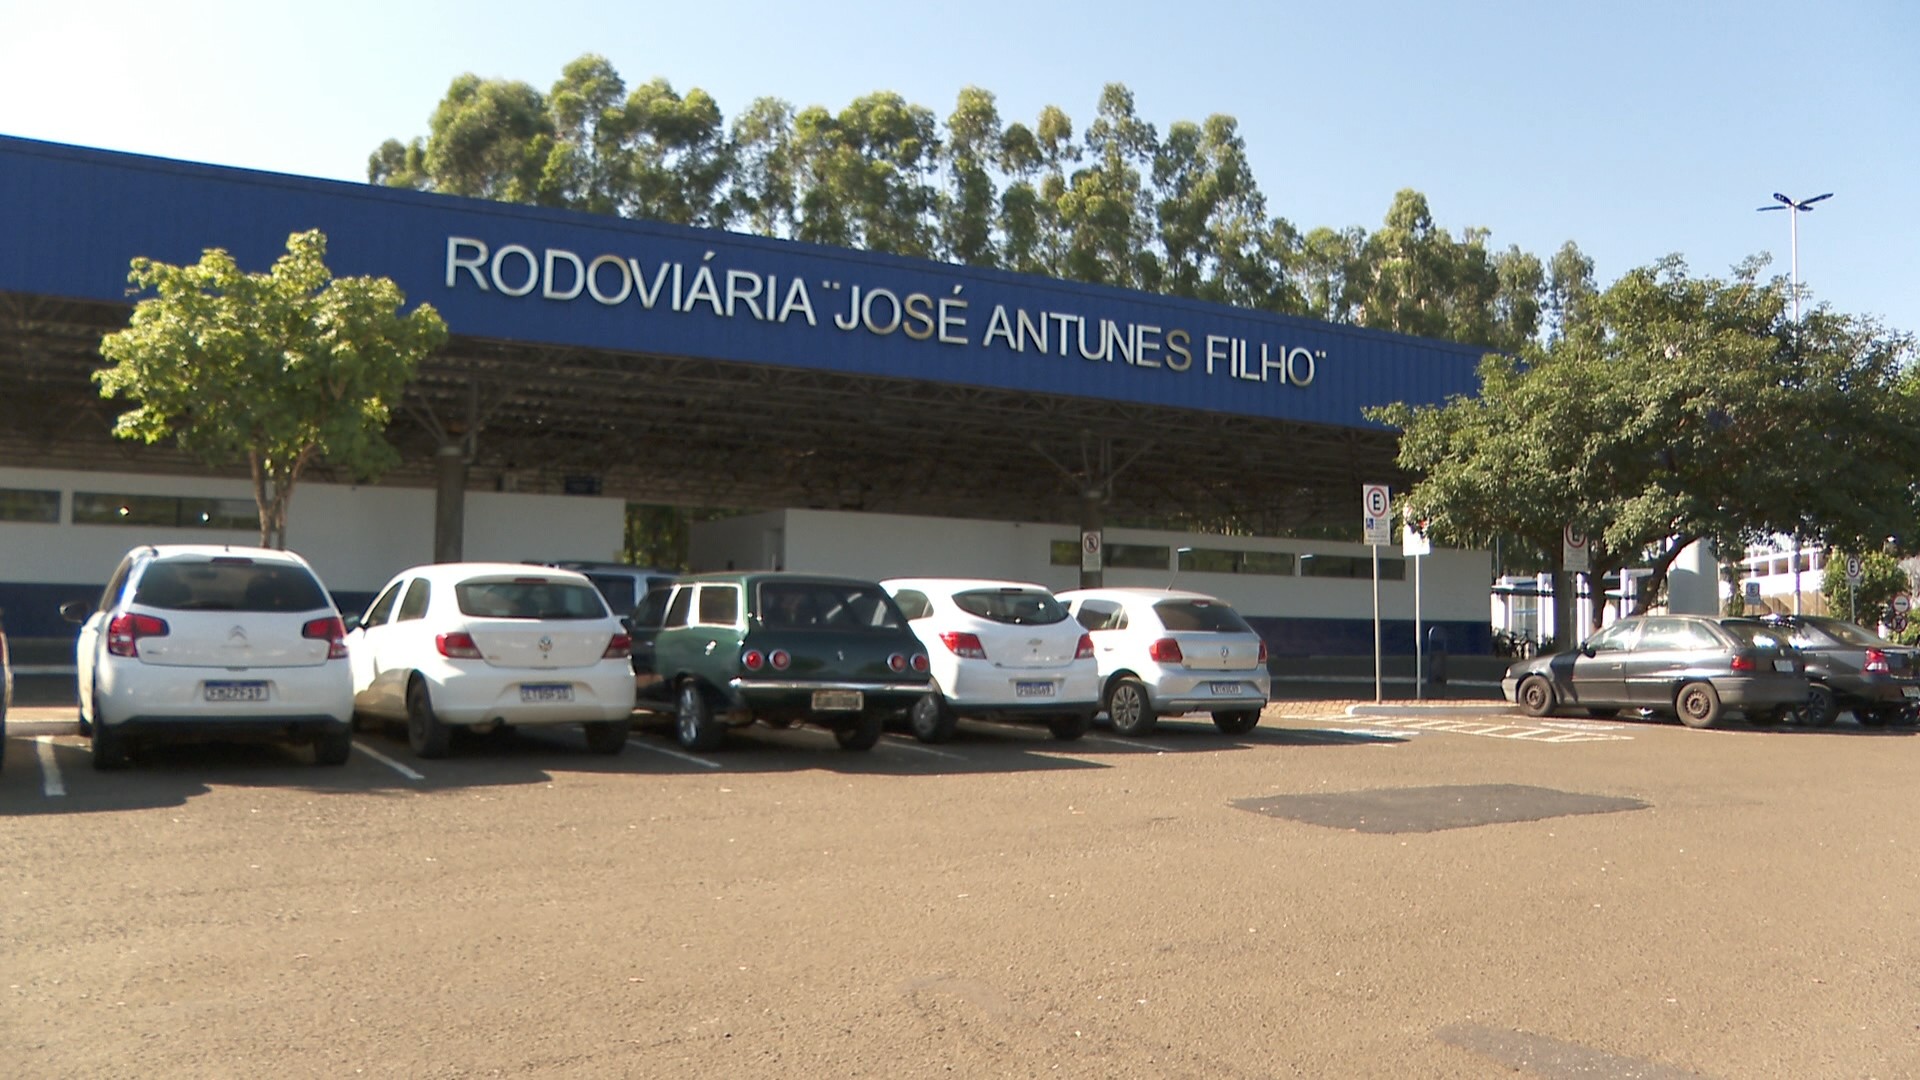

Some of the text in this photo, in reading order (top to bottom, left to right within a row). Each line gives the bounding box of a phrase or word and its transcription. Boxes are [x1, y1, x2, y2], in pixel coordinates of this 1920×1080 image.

[445, 236, 817, 327] RODOVIÁRIA
[982, 304, 1192, 372] ANTUNES
[1373, 493, 1381, 511] E
[1850, 560, 1856, 573] E
